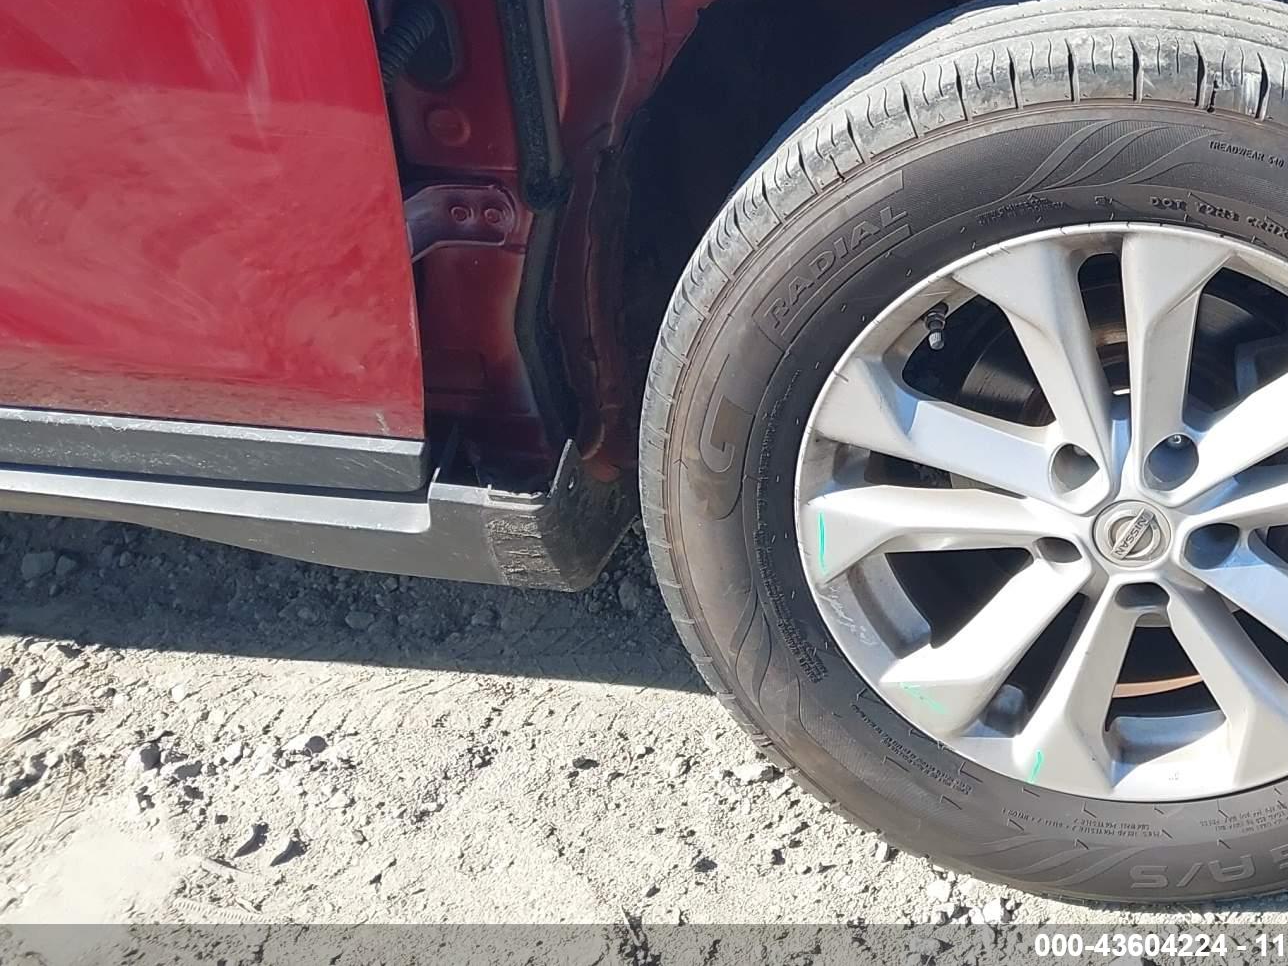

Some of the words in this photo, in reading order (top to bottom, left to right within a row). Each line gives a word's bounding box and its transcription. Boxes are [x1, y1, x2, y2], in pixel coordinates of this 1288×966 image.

[1207, 139, 1267, 162] TREADWEAR
[1149, 196, 1183, 210] DOT
[766, 204, 909, 328] RADIAL
[1115, 514, 1149, 555] NISSAN
[1129, 856, 1257, 890] A/S
